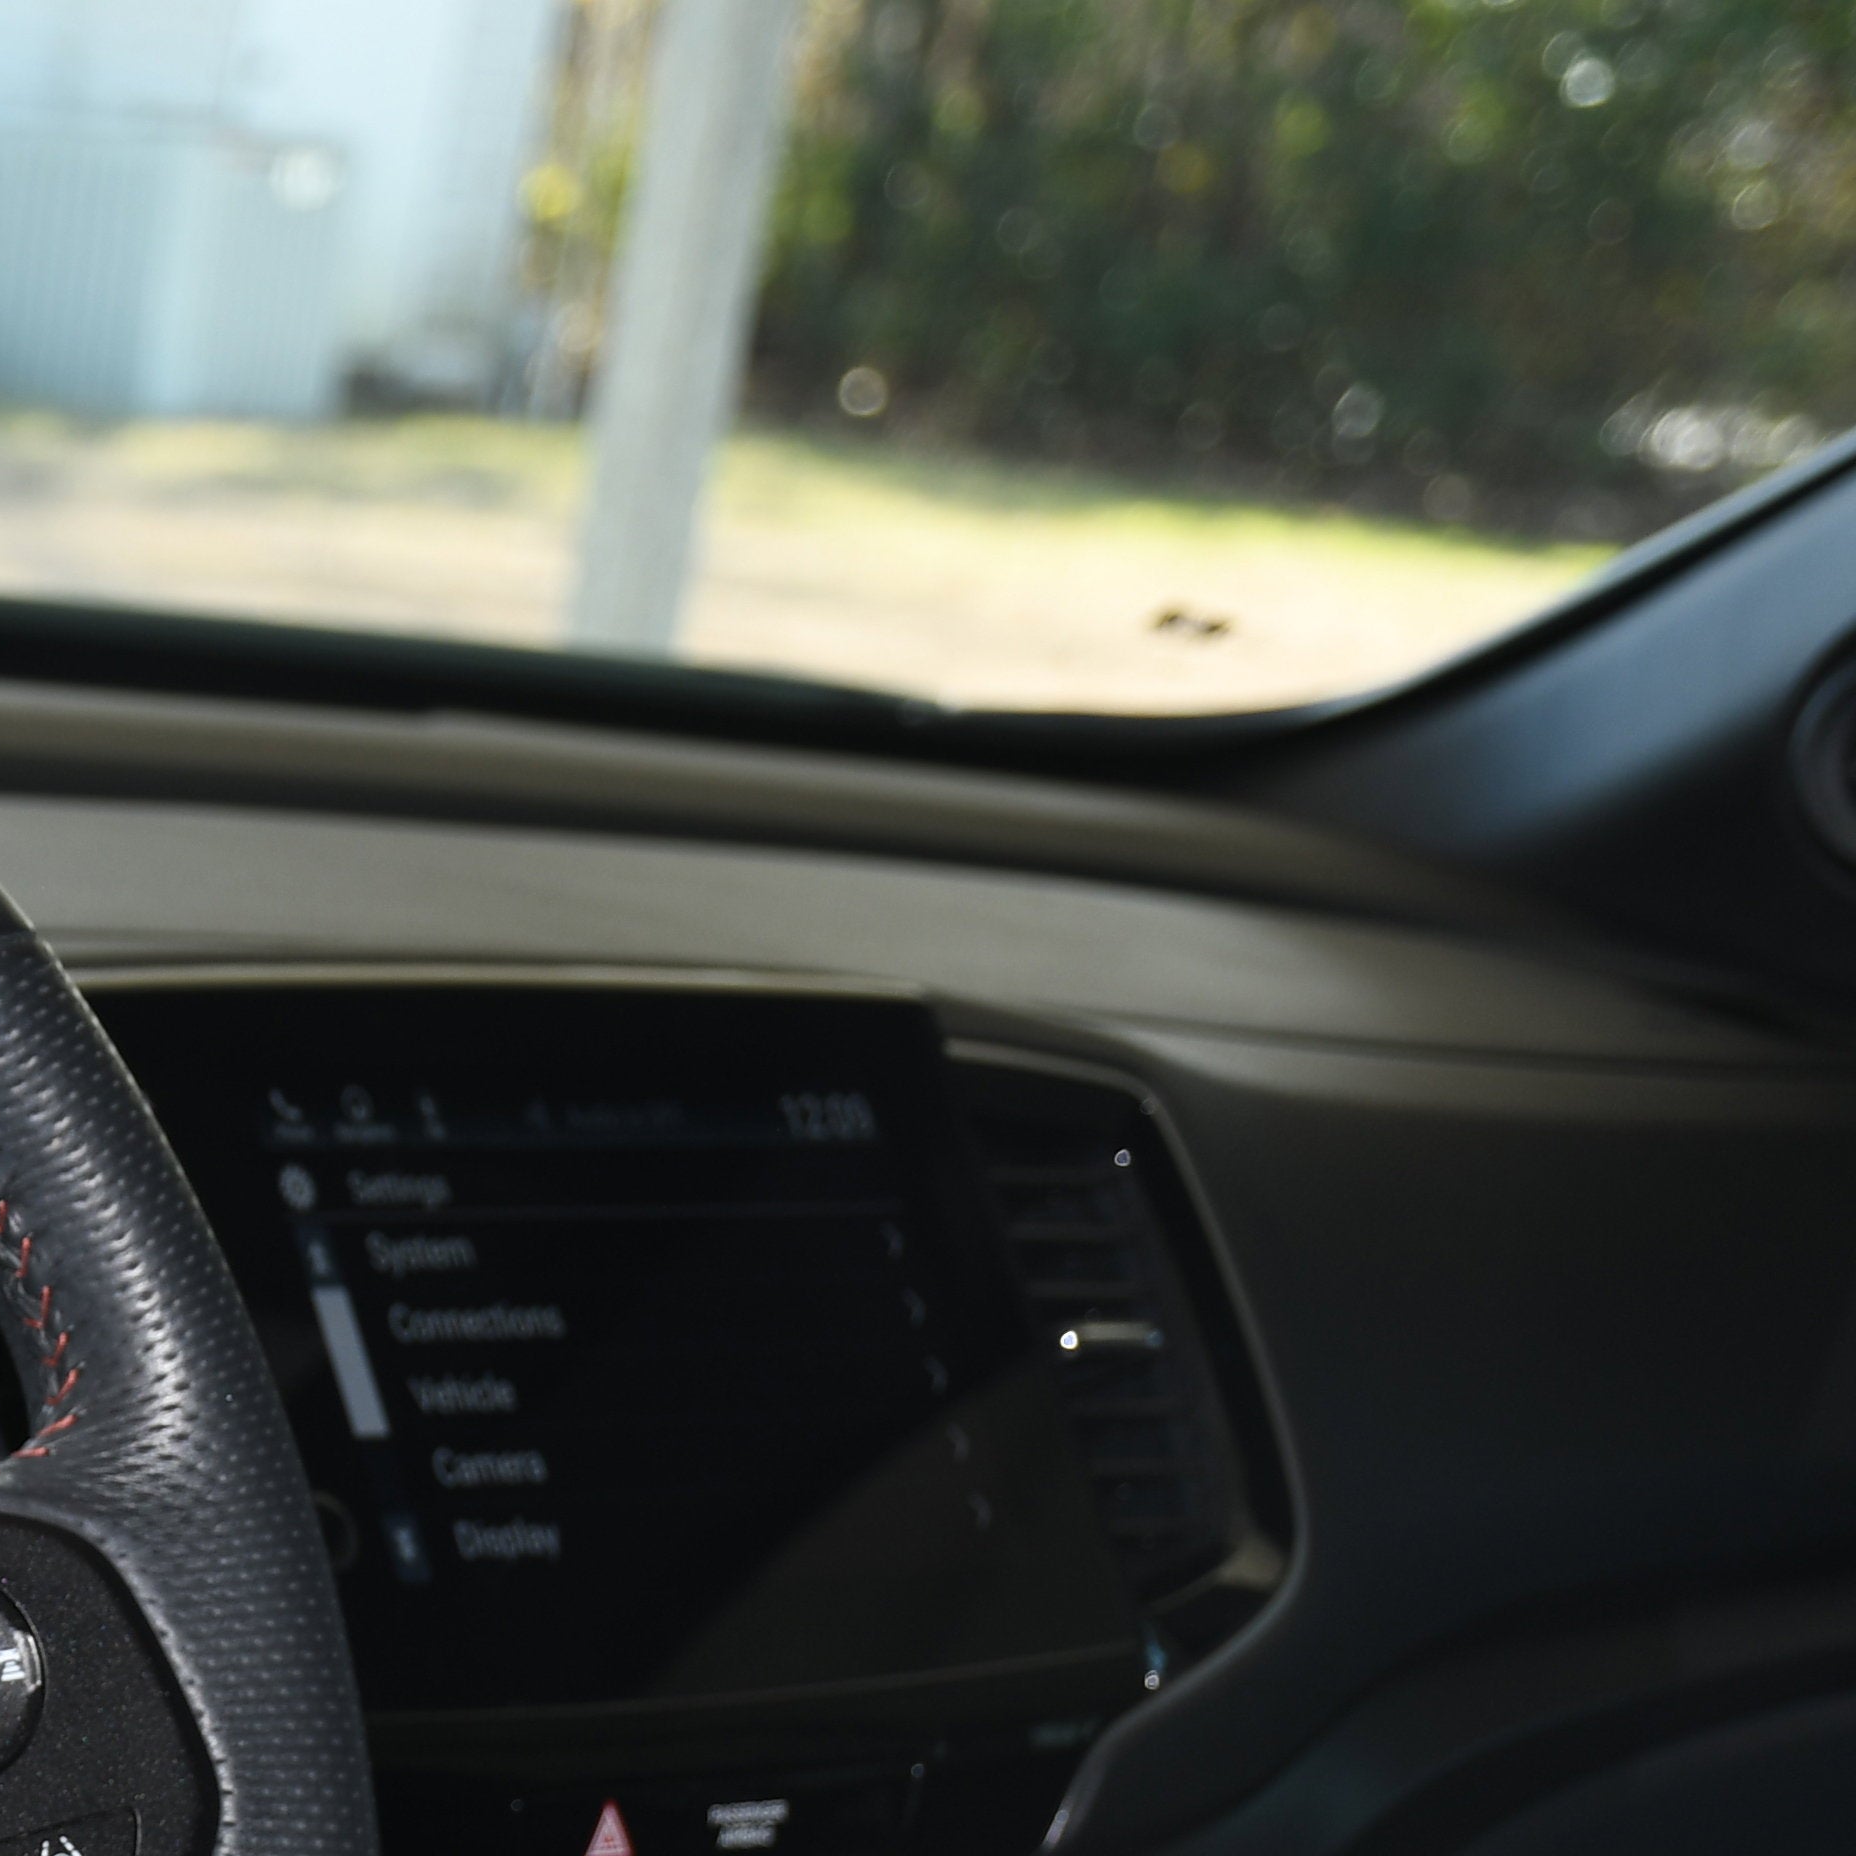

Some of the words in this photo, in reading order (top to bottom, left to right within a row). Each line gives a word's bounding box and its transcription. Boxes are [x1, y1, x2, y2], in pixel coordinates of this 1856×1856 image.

[346, 1169, 452, 1210] Settings
[364, 1230, 478, 1276] System
[387, 1302, 566, 1343] Connections
[407, 1373, 518, 1413] Vehicle
[432, 1446, 549, 1488] Camera
[452, 1519, 561, 1560] Display
